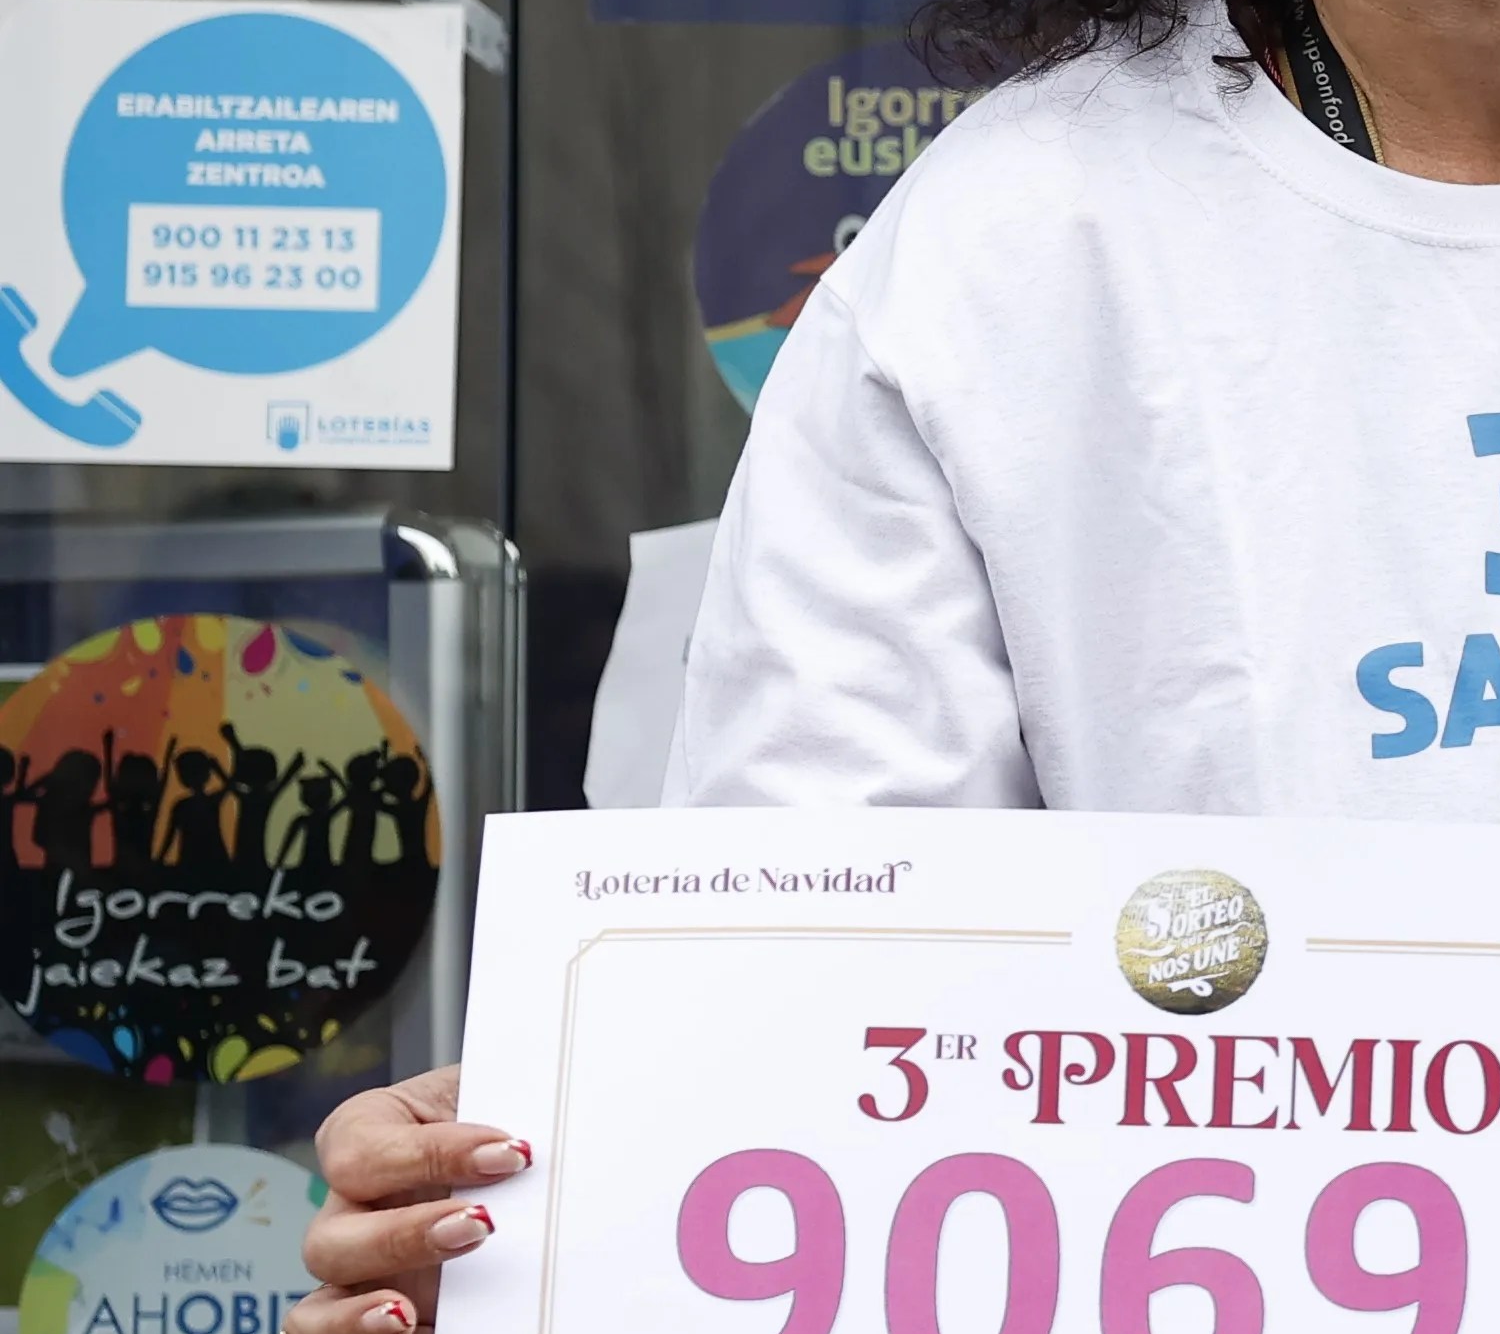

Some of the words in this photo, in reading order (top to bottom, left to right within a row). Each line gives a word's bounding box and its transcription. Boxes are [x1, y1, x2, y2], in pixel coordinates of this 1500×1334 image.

[117, 93, 398, 123] ERABILTZAILEAREN
[196, 130, 312, 154] ARRETA
[803, 125, 932, 176] eusk
[187, 163, 326, 188] ZENTROA
[152, 224, 221, 249] 900
[236, 224, 259, 249] 11
[272, 226, 310, 250] 23
[324, 228, 355, 251] 13
[144, 263, 197, 289] 915
[210, 263, 251, 289] 96
[266, 264, 303, 289] 23
[316, 264, 361, 290] 00
[574, 867, 701, 900] Lotería
[710, 867, 750, 894] de
[758, 860, 913, 895] Navidad
[55, 869, 344, 948] Igorreko
[16, 934, 241, 1015] jaiekaz
[267, 937, 376, 990] bat
[1149, 953, 1190, 984] NOS
[1194, 936, 1240, 971] UNE
[163, 1261, 252, 1283] HEMEN
